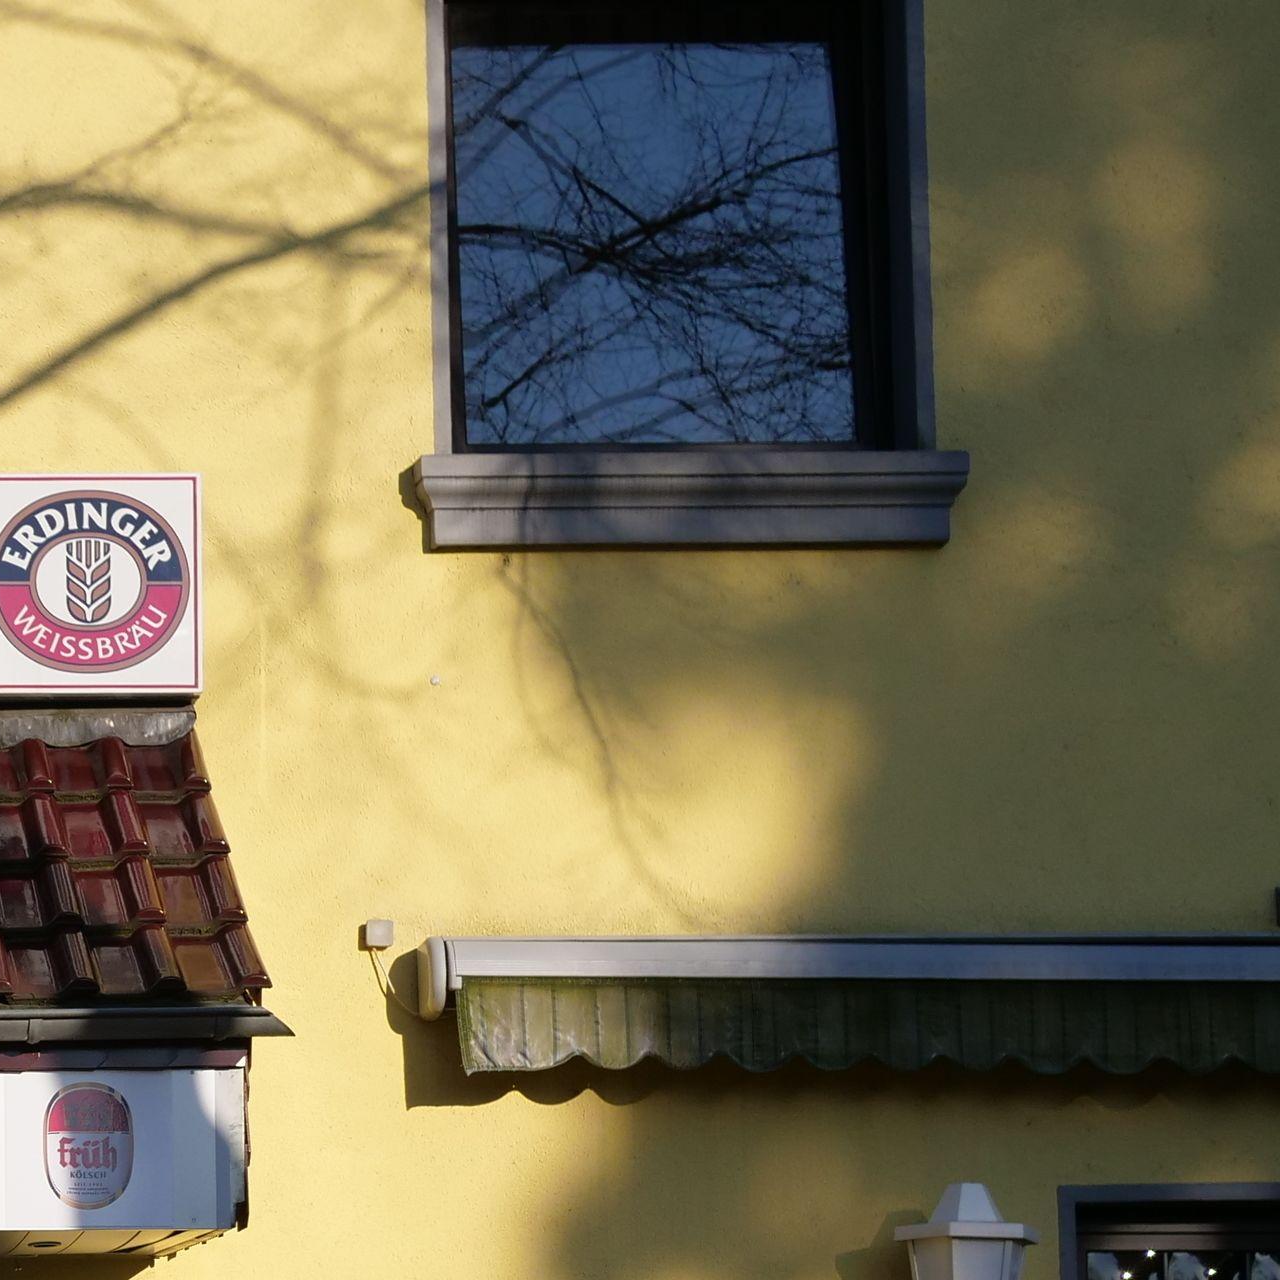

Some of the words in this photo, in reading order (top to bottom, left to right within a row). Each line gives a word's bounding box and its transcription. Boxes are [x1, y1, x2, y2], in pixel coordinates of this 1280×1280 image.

[1, 501, 172, 571] ERDINGER
[13, 604, 168, 660] WEISSBRÄU
[69, 1169, 107, 1179] KÖLSCH
